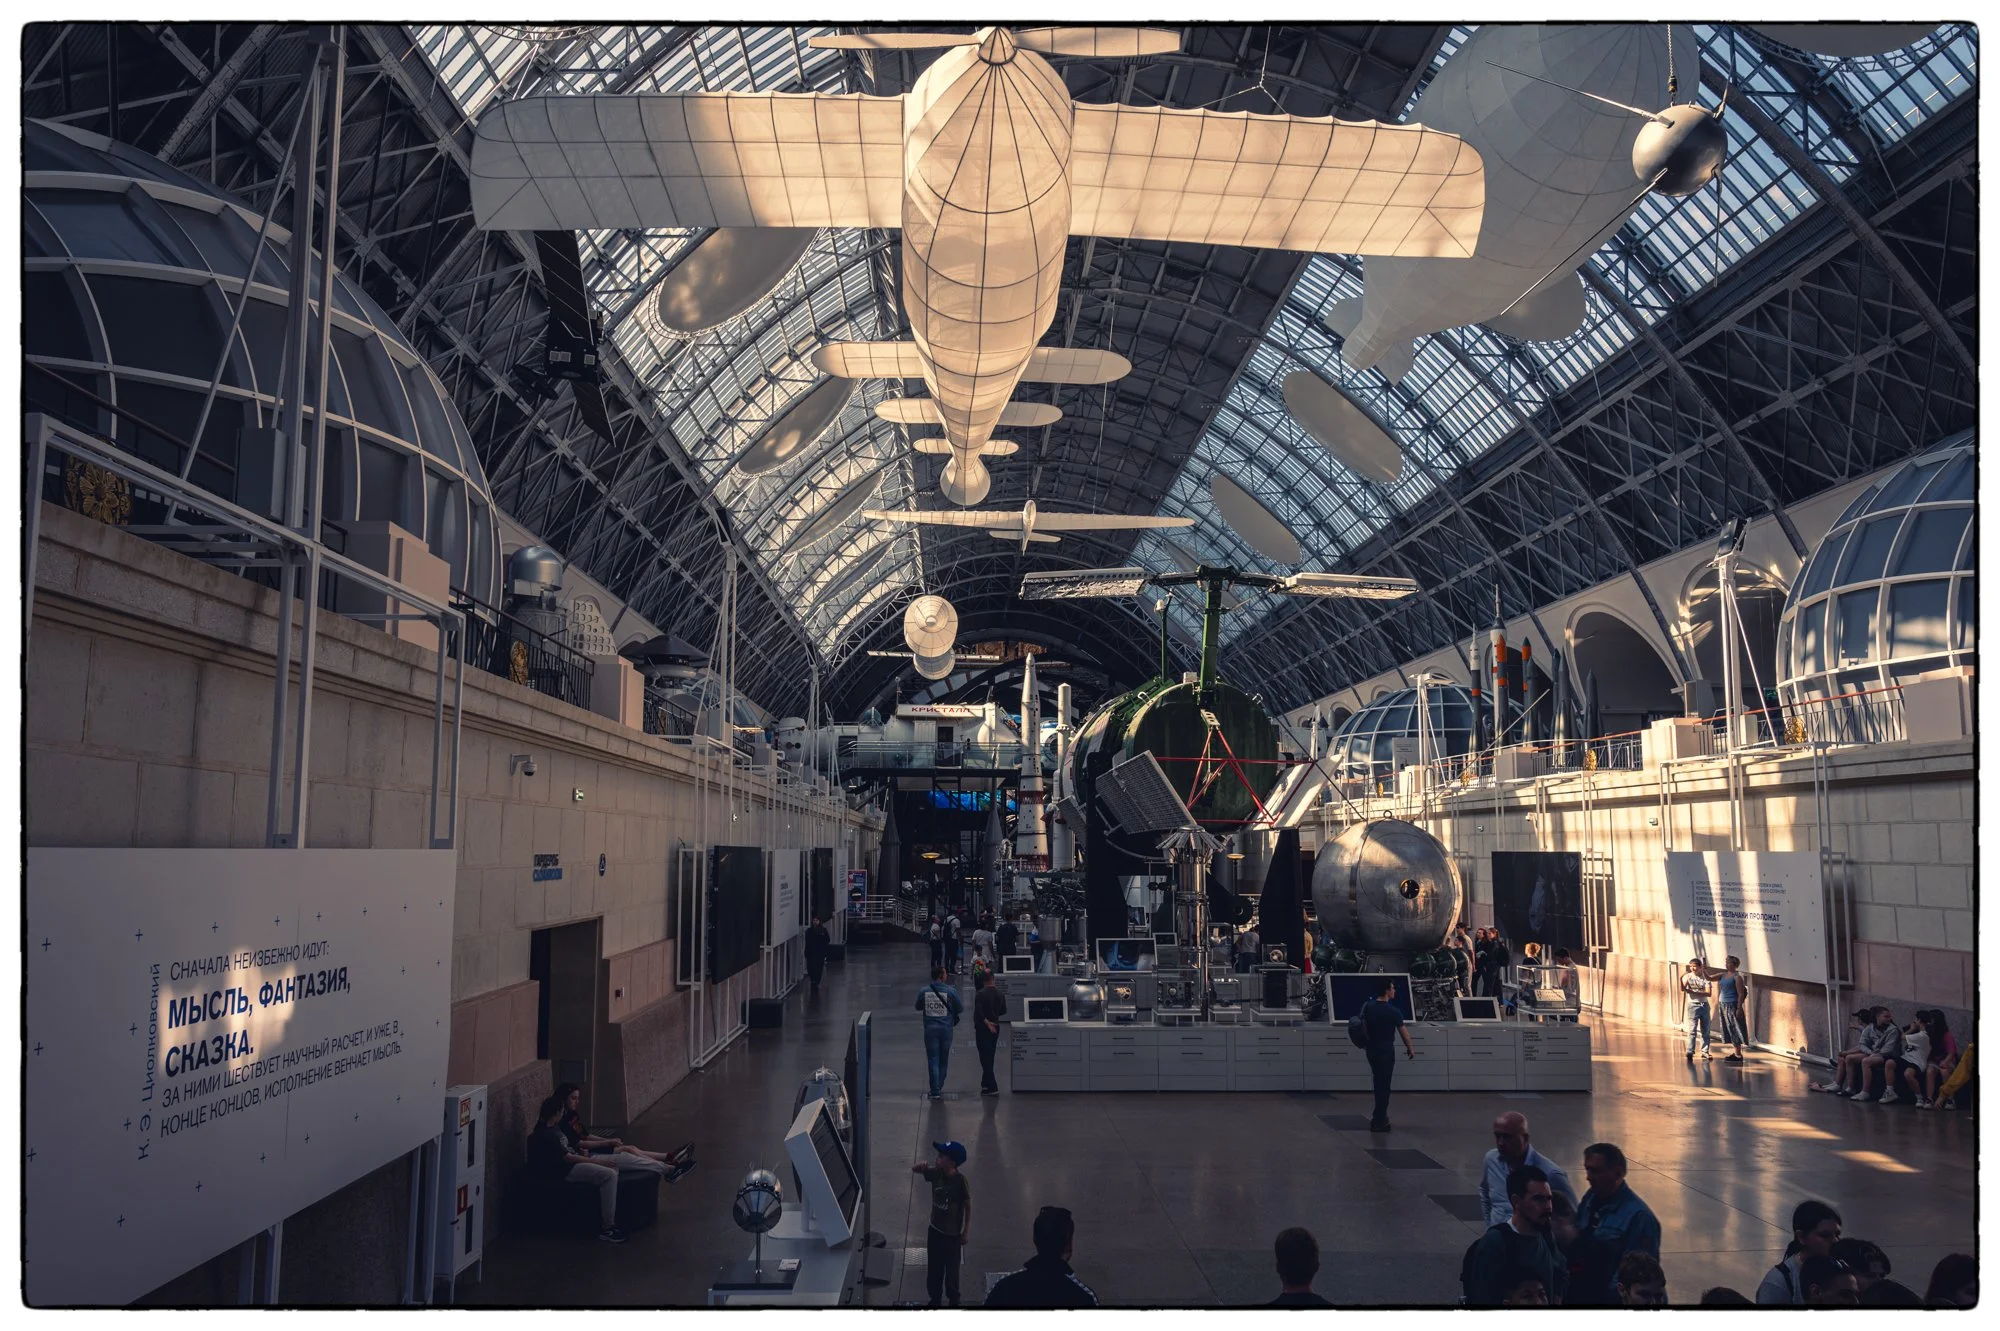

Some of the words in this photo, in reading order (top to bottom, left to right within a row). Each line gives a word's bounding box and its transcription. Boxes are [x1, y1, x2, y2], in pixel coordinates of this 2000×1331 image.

[170, 955, 230, 981] СНАЧАЛА
[233, 944, 300, 970] НЕИЗБЕЖНО
[302, 940, 330, 960] ИДУТ:
[168, 987, 253, 1029] МЫСЛЬ,
[258, 966, 351, 1008] ФАНТАЗИЯ,
[142, 963, 160, 1102] Циолковский
[165, 1029, 254, 1078] СКАЗКА.
[162, 1086, 180, 1108] ЗА
[184, 1073, 221, 1101] НИМИ
[223, 1055, 281, 1089] ШЕСТВУЕТ
[283, 1038, 330, 1070] НАУЧНЫЙ
[331, 1030, 365, 1054] РАСЧЕТ,
[366, 1028, 373, 1041] И
[393, 1020, 399, 1034] В
[139, 1108, 152, 1132] Э.
[160, 1105, 207, 1138] КОНЦЕ
[210, 1087, 262, 1120] КОНЦОВ,
[264, 1062, 333, 1101] ИСПОЛНЕНИЕ
[334, 1049, 372, 1076] ВЕНЧАЕТ
[138, 1138, 150, 1161] К.
